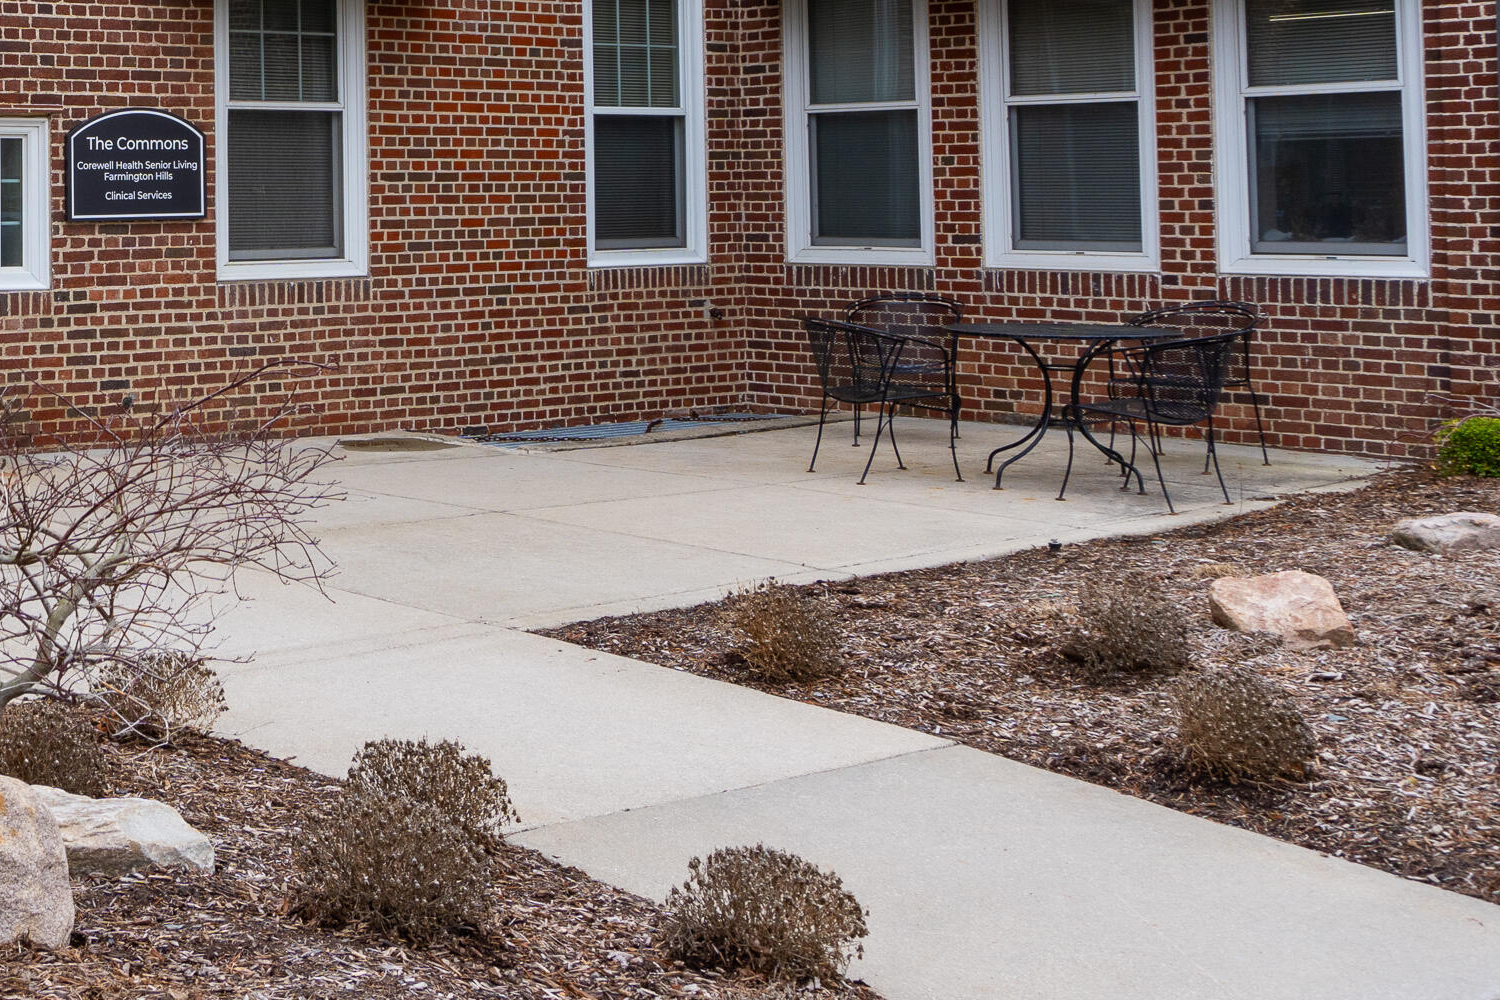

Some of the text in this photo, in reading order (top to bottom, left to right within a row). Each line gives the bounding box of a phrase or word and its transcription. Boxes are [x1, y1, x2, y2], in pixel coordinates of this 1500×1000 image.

[86, 136, 188, 150] The Commons
[76, 160, 198, 171] Corewell Health Senior Living
[104, 171, 173, 182] Farmington Hills
[105, 190, 172, 200] Clinical Services
